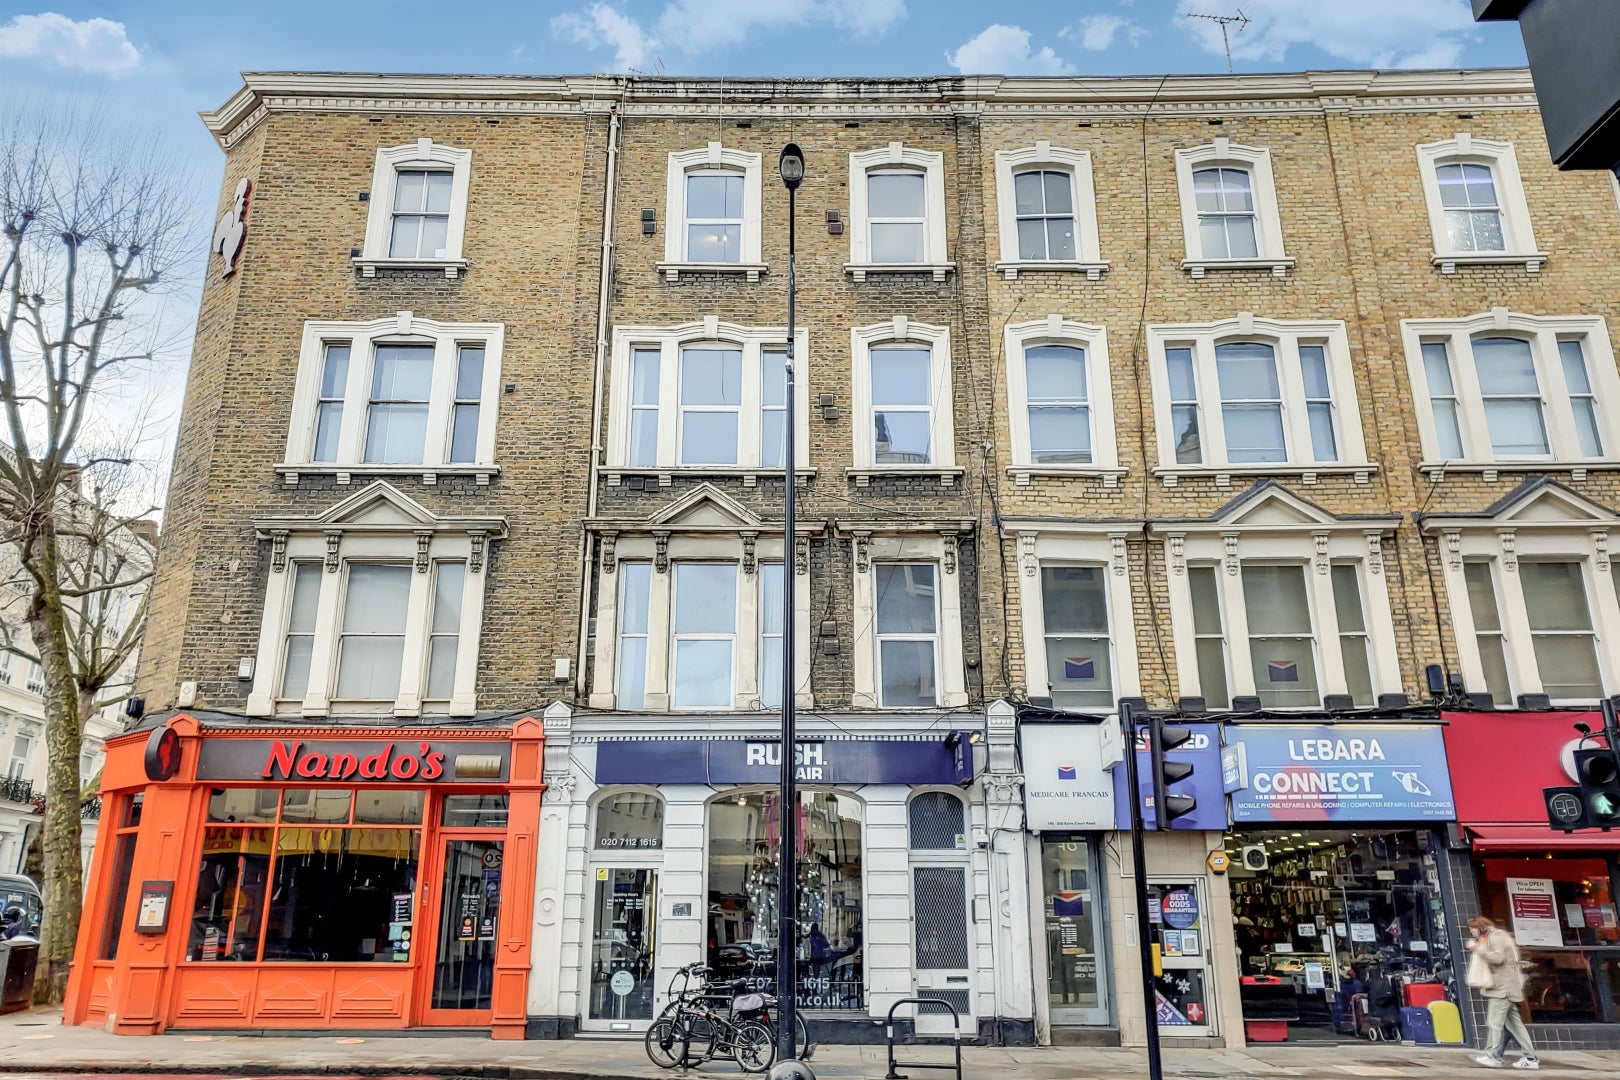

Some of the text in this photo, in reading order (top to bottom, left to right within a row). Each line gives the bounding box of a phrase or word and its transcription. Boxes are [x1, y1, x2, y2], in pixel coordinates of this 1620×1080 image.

[1288, 739, 1386, 761] LEBARA
[261, 741, 444, 779] Nando's
[795, 767, 823, 780] AIR
[1253, 771, 1375, 794] CONNECT
[601, 838, 657, 846] 020 7112 1615
[1170, 900, 1191, 908] ODDS
